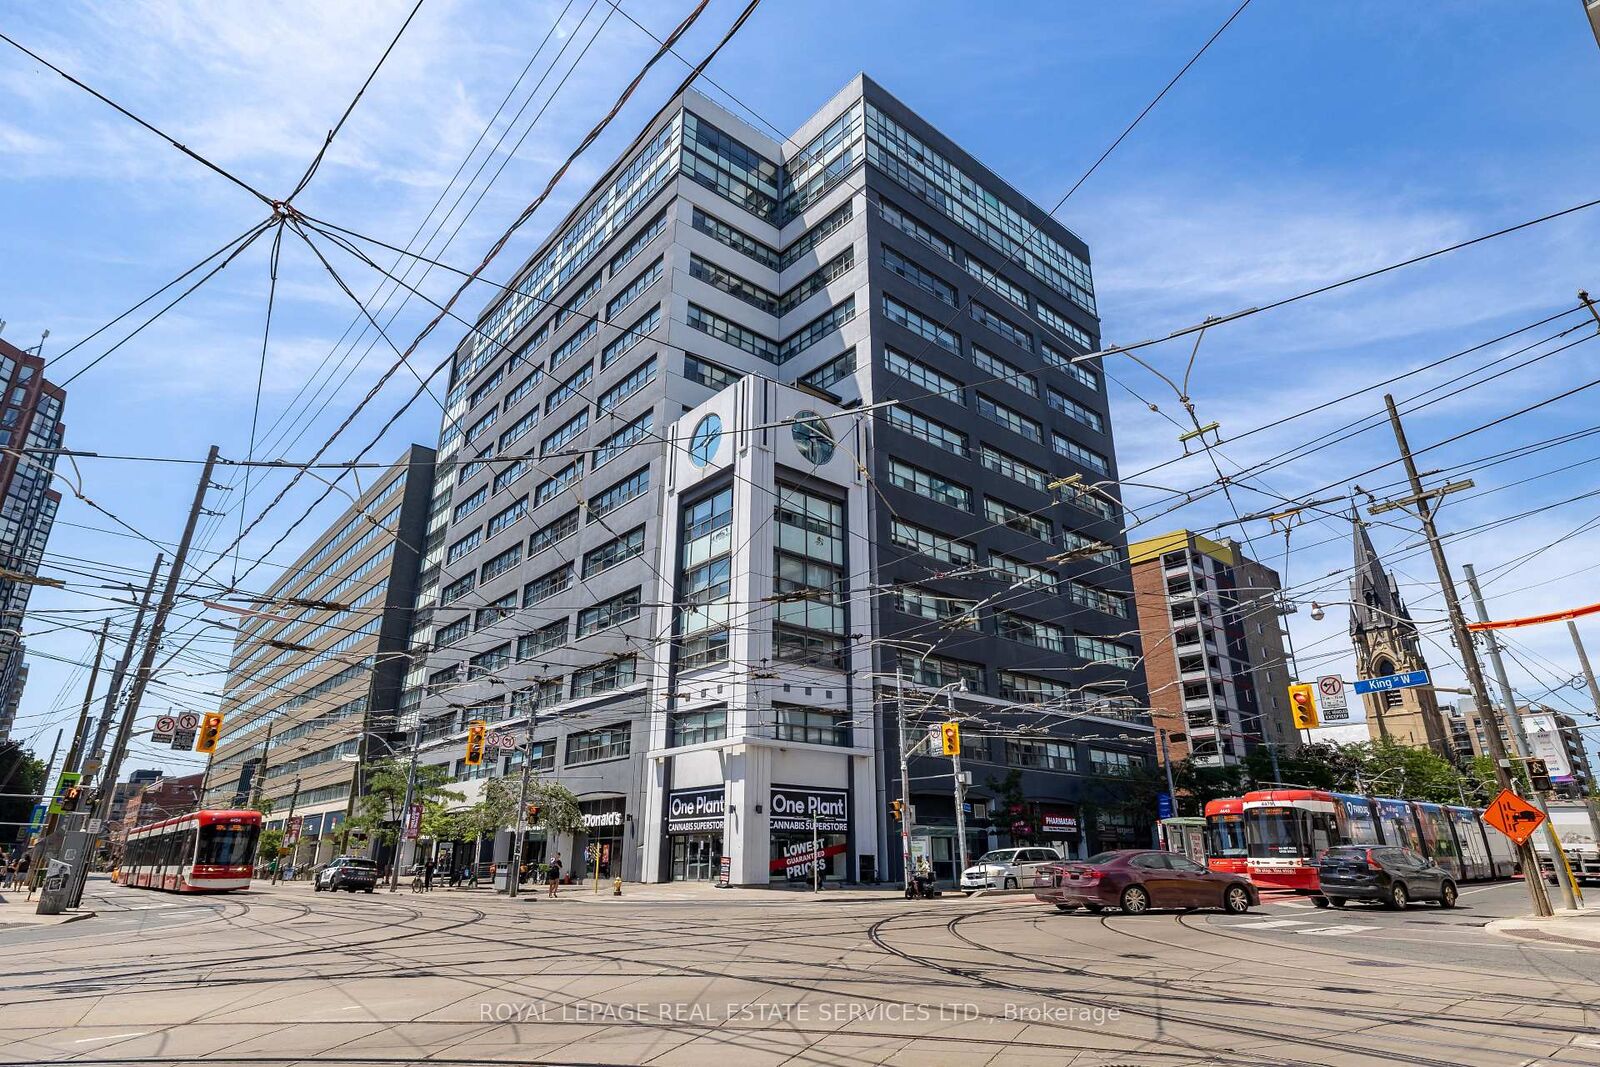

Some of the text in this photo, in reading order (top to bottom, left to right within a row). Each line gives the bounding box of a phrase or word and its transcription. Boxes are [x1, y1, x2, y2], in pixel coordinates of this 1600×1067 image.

[1368, 679, 1392, 689] King
[1400, 674, 1410, 684] W
[672, 796, 724, 815] One Plant
[773, 794, 843, 815] One Plant
[668, 820, 724, 832] CANNABIS SUPERSTOR
[770, 821, 847, 831] CANNABIS SUPERSTORE
[783, 838, 825, 857] LOWEST
[786, 858, 826, 879] PRICES
